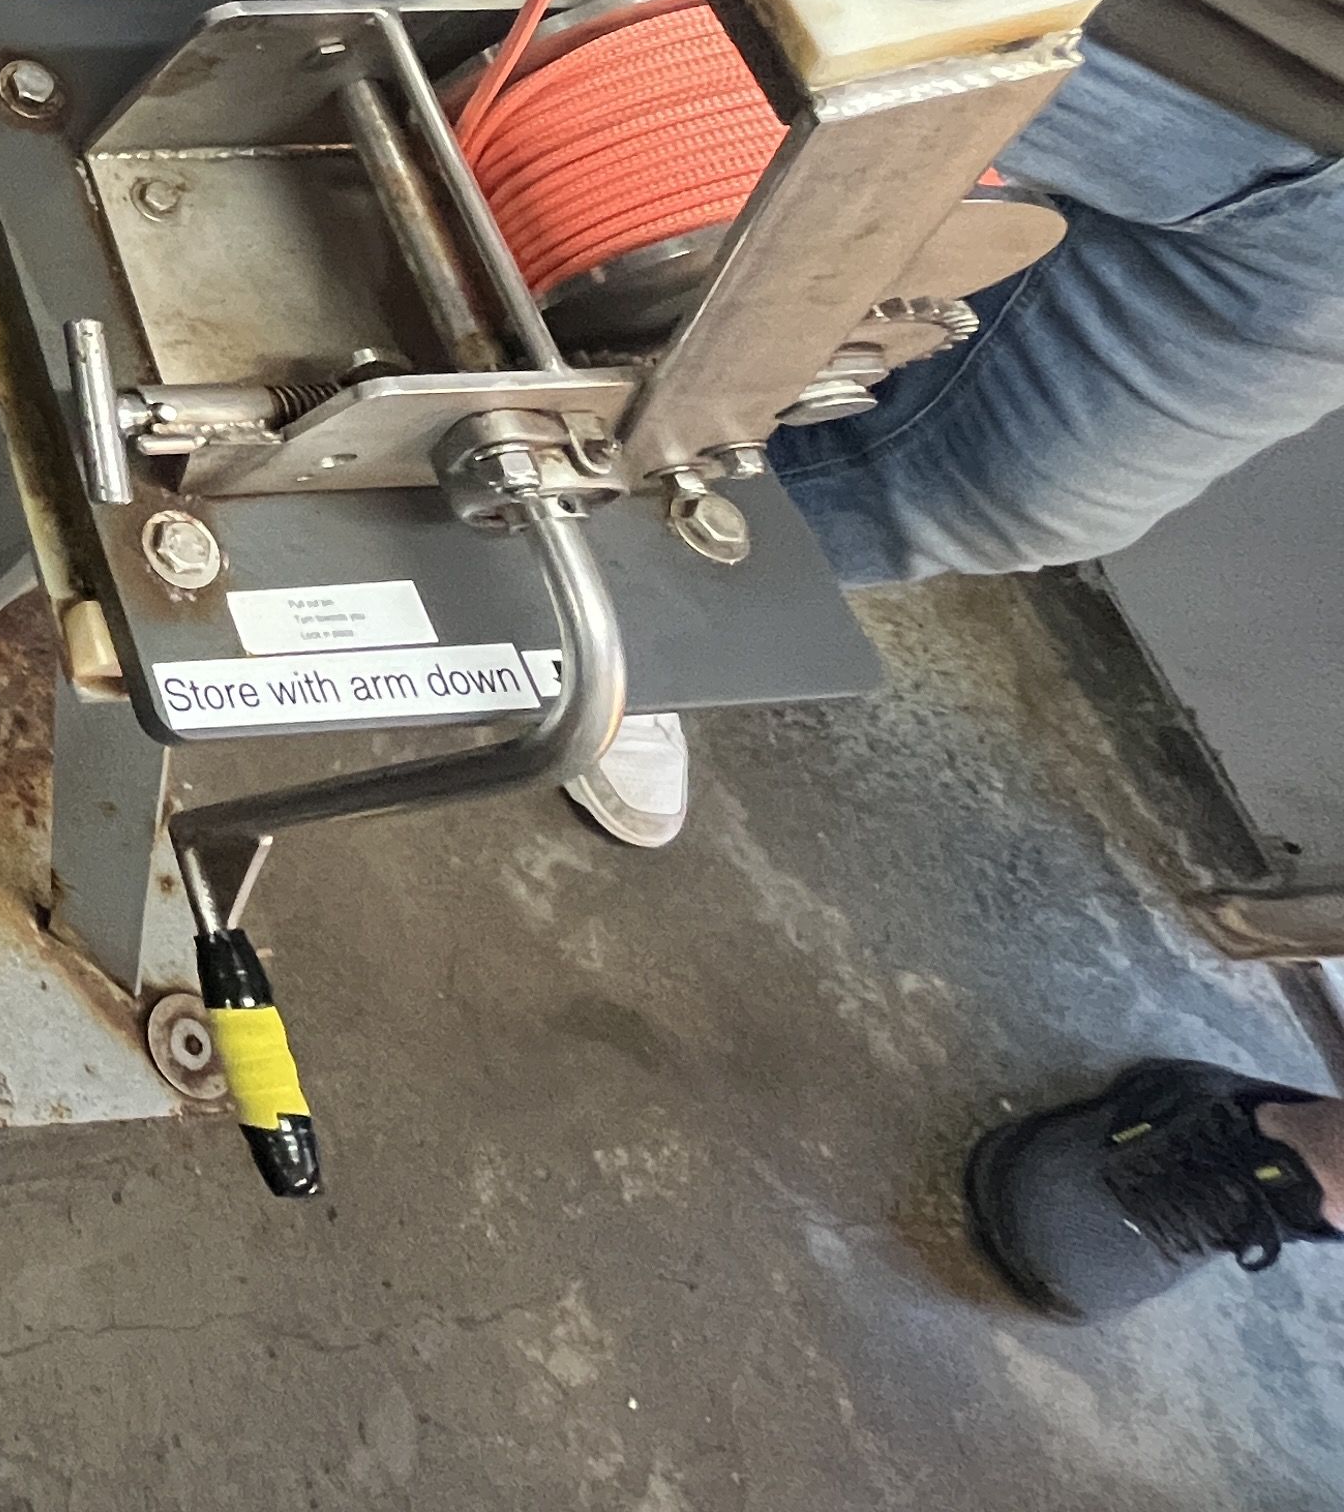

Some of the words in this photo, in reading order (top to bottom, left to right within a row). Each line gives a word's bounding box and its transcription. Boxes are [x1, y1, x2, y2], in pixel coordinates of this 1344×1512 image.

[164, 677, 261, 712] Store
[268, 669, 341, 706] with
[350, 672, 419, 702] arm
[427, 662, 521, 697] down
